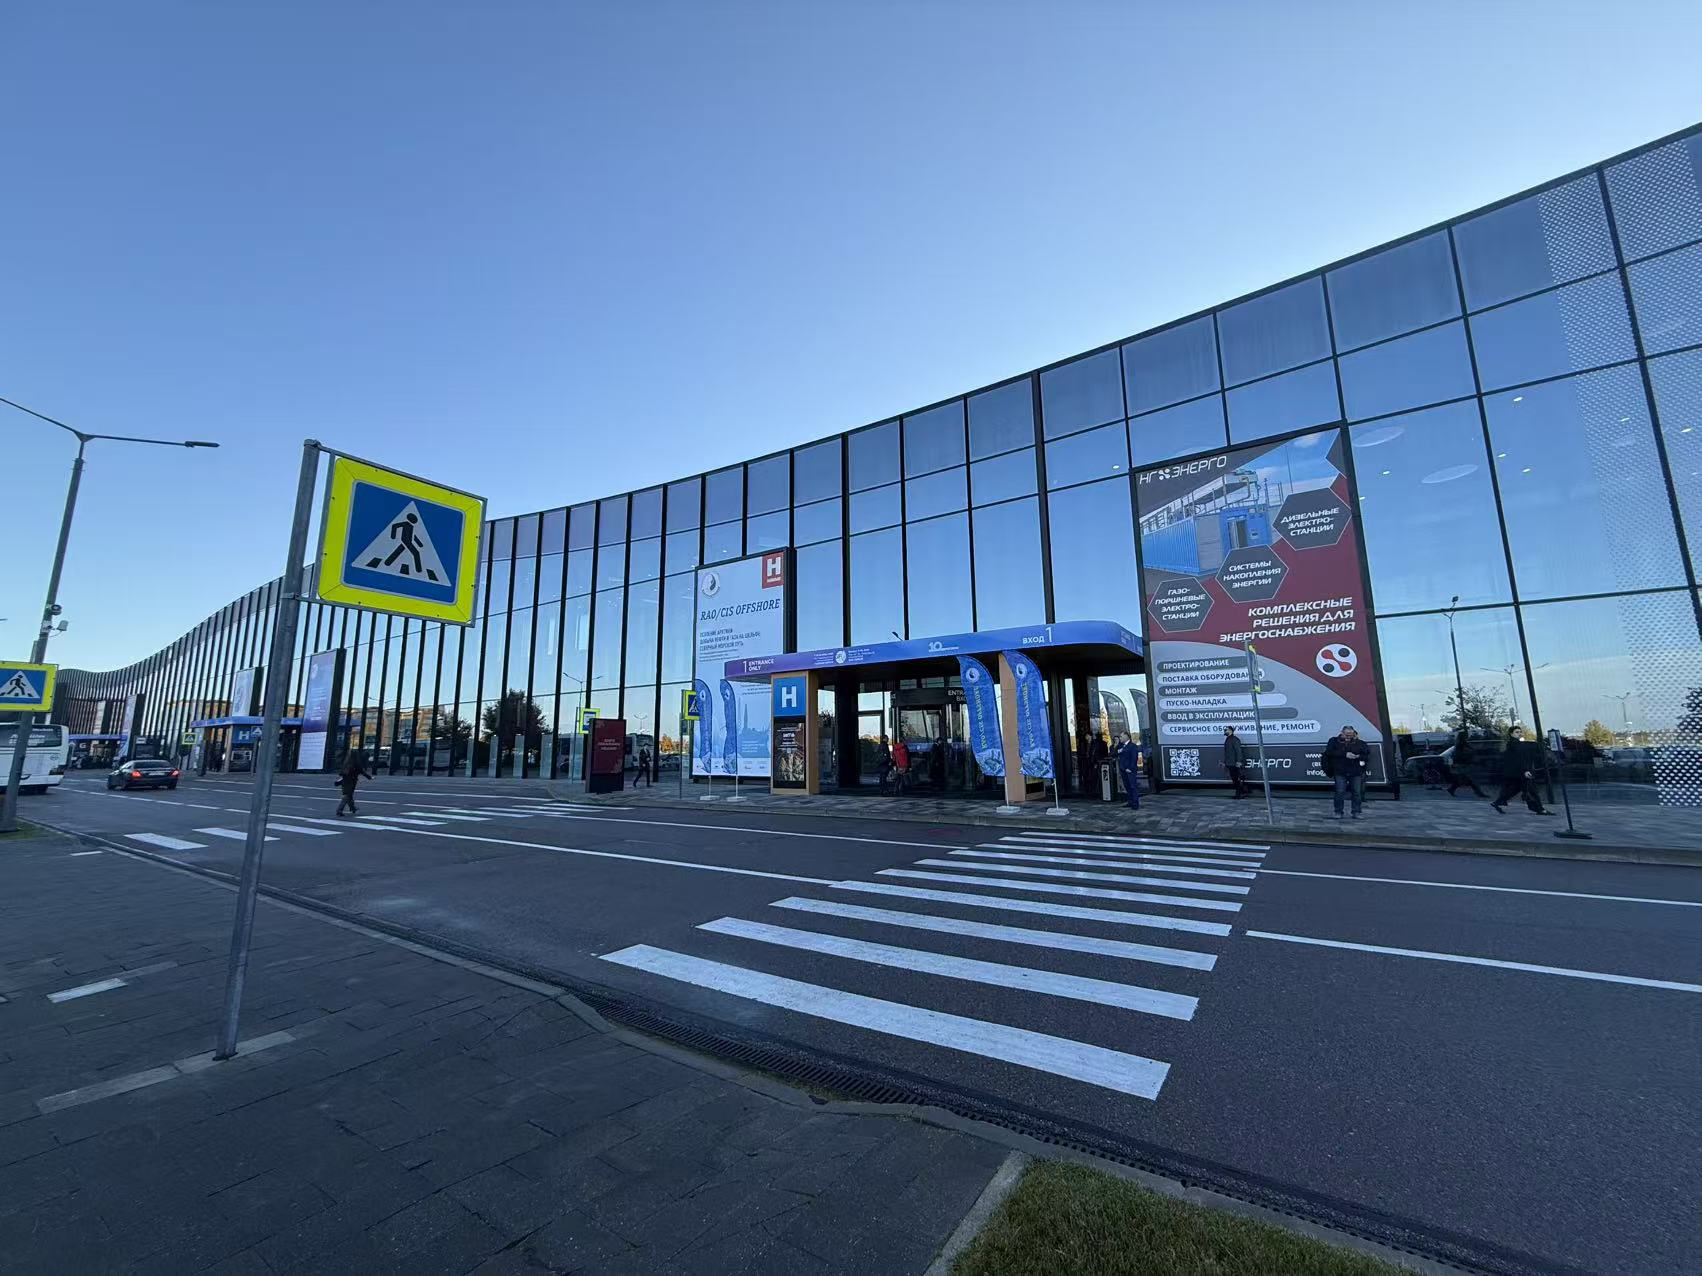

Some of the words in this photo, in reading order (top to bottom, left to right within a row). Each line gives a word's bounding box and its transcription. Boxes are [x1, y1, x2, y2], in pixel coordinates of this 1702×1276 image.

[1171, 455, 1227, 478] ЭНЕРГО
[1280, 507, 1340, 524] ДИЗЕЛЬНЫЕ
[1288, 516, 1335, 529] ЭЛЕКТРО-
[1290, 523, 1335, 536] СТАНЦИИ
[1228, 560, 1272, 572] СИСТЕМЫ
[1223, 568, 1281, 581] НАКОПЛЕНИЯ
[1231, 577, 1272, 589] ЭНЕРГИИ
[1167, 587, 1191, 596] ГАЗО-
[1154, 593, 1206, 605] ПОРШНЕВЫЕ
[700, 605, 734, 621] RAO/CIS
[735, 598, 781, 615] OFFSHORE
[1160, 603, 1201, 613] ЭЛЕКТРО-
[1248, 597, 1353, 617] КОМПЛЕКСНЫЕ
[1162, 611, 1200, 620] СТАНЦИИ
[1253, 613, 1320, 628] РЕШЕНИЯ
[1321, 609, 1355, 622] ДЛЯ
[1022, 635, 1045, 644] ВХОД
[1045, 626, 1052, 643] 1
[1219, 621, 1356, 642] ЭНЕРГОСНАБЖЕНИЯ
[743, 661, 747, 673] 1
[1163, 659, 1229, 670] ПРОЕКТИРОВАНИЕ
[1162, 674, 1199, 683] ПОСТАВКА
[1200, 671, 1263, 681] ОБОРУДОВАЯ
[781, 685, 797, 708] H
[1166, 698, 1227, 706] ПУСКО-НАЛАДКА
[1167, 713, 1188, 721] ВВОД
[1212, 724, 1280, 733] ОБСУЖИВНИЕ,
